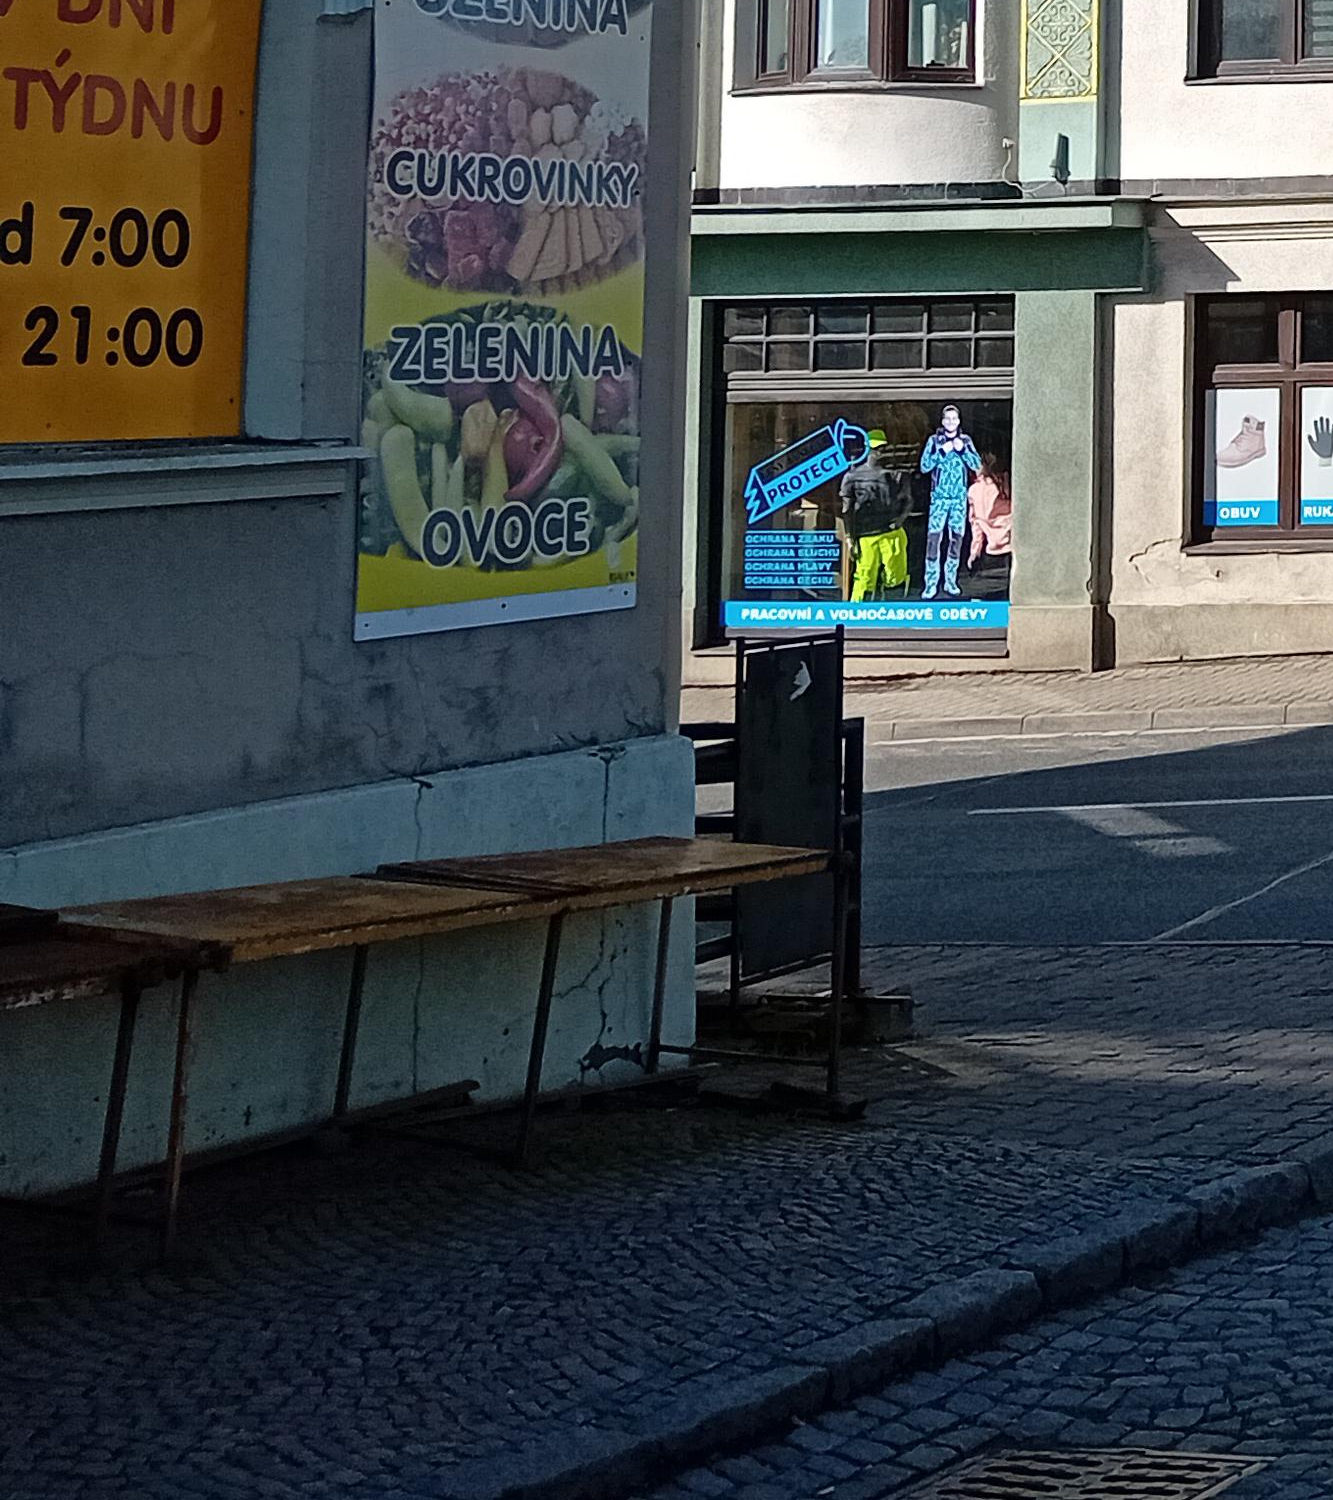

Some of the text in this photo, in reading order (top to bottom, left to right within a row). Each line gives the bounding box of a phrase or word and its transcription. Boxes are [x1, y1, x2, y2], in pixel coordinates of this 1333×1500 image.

[3, 49, 223, 145] TÝDNU
[385, 151, 638, 206] CUKROVINKY
[59, 206, 190, 268] 7:00
[22, 304, 204, 368] 21:00
[388, 326, 626, 383] ZELENINA
[767, 451, 840, 504] PROTECT
[422, 500, 590, 569] OVOCE
[745, 535, 795, 543] OCHRANA
[1220, 506, 1260, 519] OBUV
[745, 549, 795, 557] OCHRANA
[797, 562, 832, 570] HLAVY
[741, 606, 988, 621] PRACOVNÍ A VOLNOČASOVÉ ODĚVY
